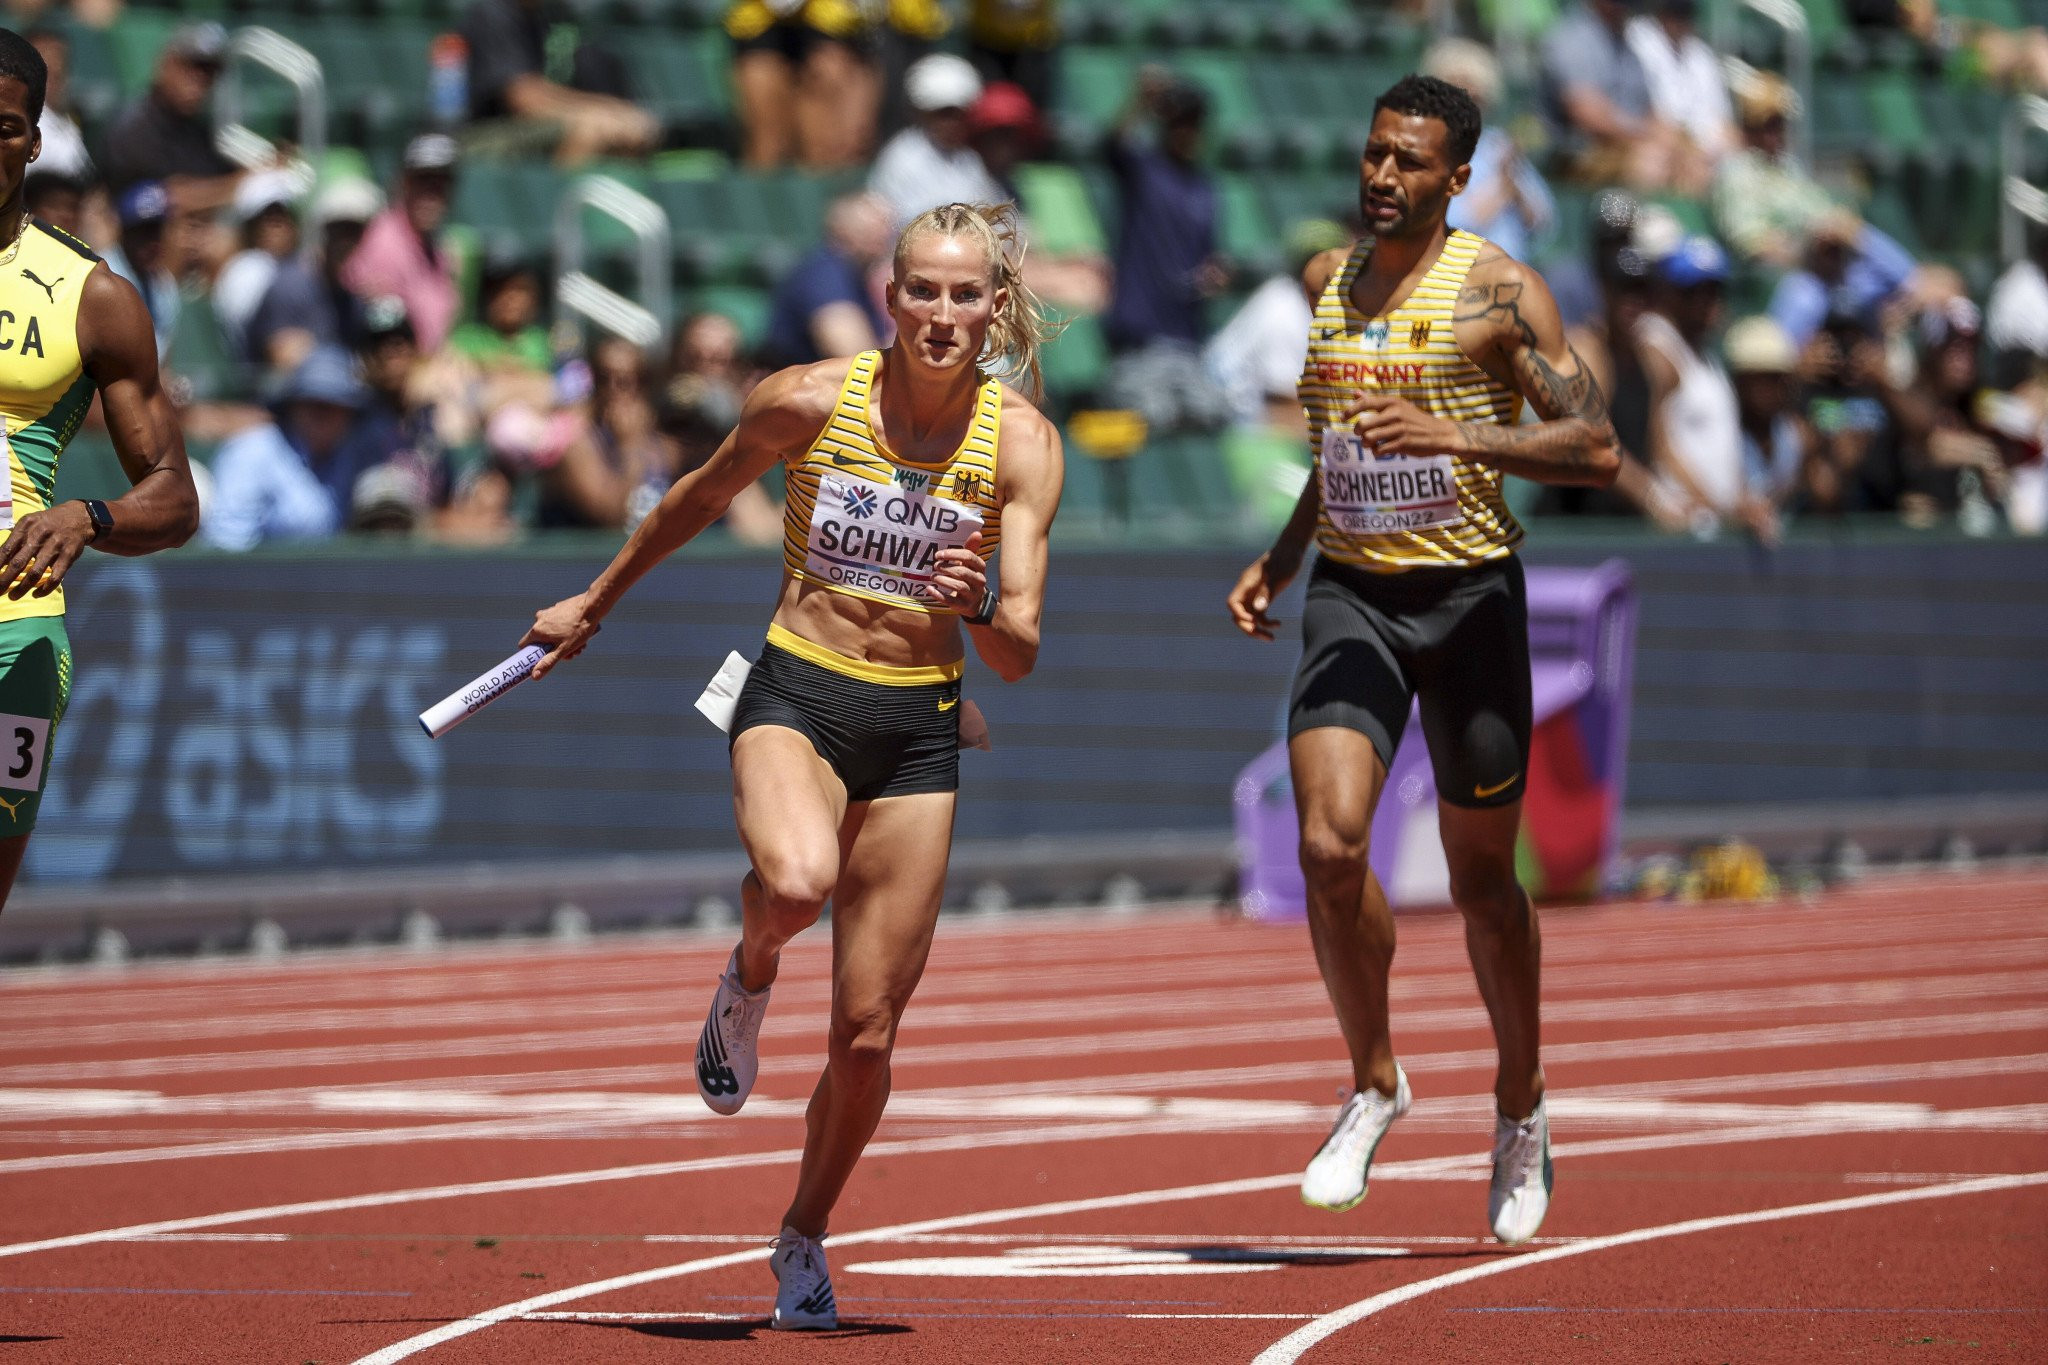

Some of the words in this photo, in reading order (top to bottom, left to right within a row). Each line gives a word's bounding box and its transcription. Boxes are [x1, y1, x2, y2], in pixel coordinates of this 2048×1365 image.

[1315, 361, 1426, 384] GERMANY
[1326, 467, 1448, 503] SCHNEIDER
[884, 497, 960, 533] QNB
[1341, 510, 1436, 529] OREGON22
[818, 519, 964, 572] SCHWA
[461, 676, 501, 705] WORLD
[9, 727, 35, 779] 3
